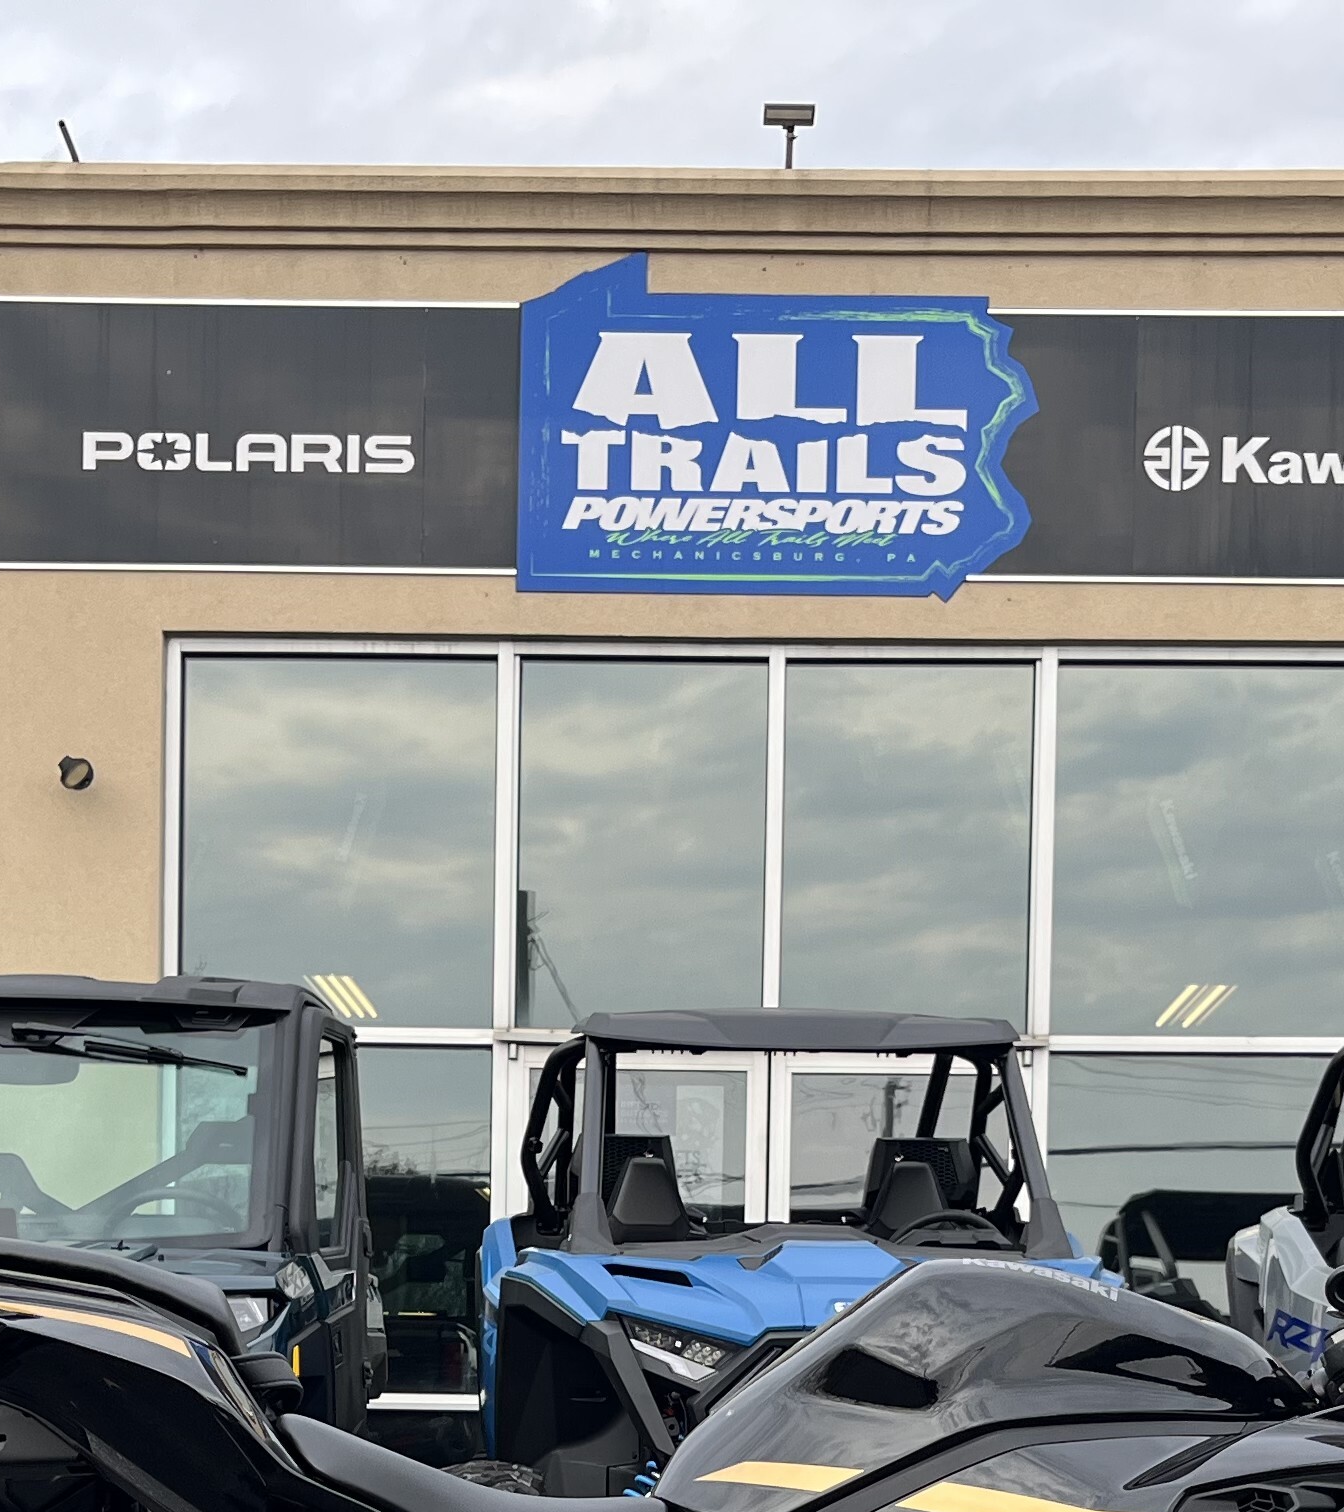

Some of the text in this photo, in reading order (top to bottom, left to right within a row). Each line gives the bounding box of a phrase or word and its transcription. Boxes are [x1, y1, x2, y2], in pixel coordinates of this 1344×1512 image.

[571, 331, 968, 432] ALL
[81, 431, 416, 474] POLARIS
[560, 428, 968, 497] TRAILS
[561, 495, 965, 536] POWERSPORTS
[605, 527, 899, 549] Where All Trails Meet
[886, 552, 917, 564] PA
